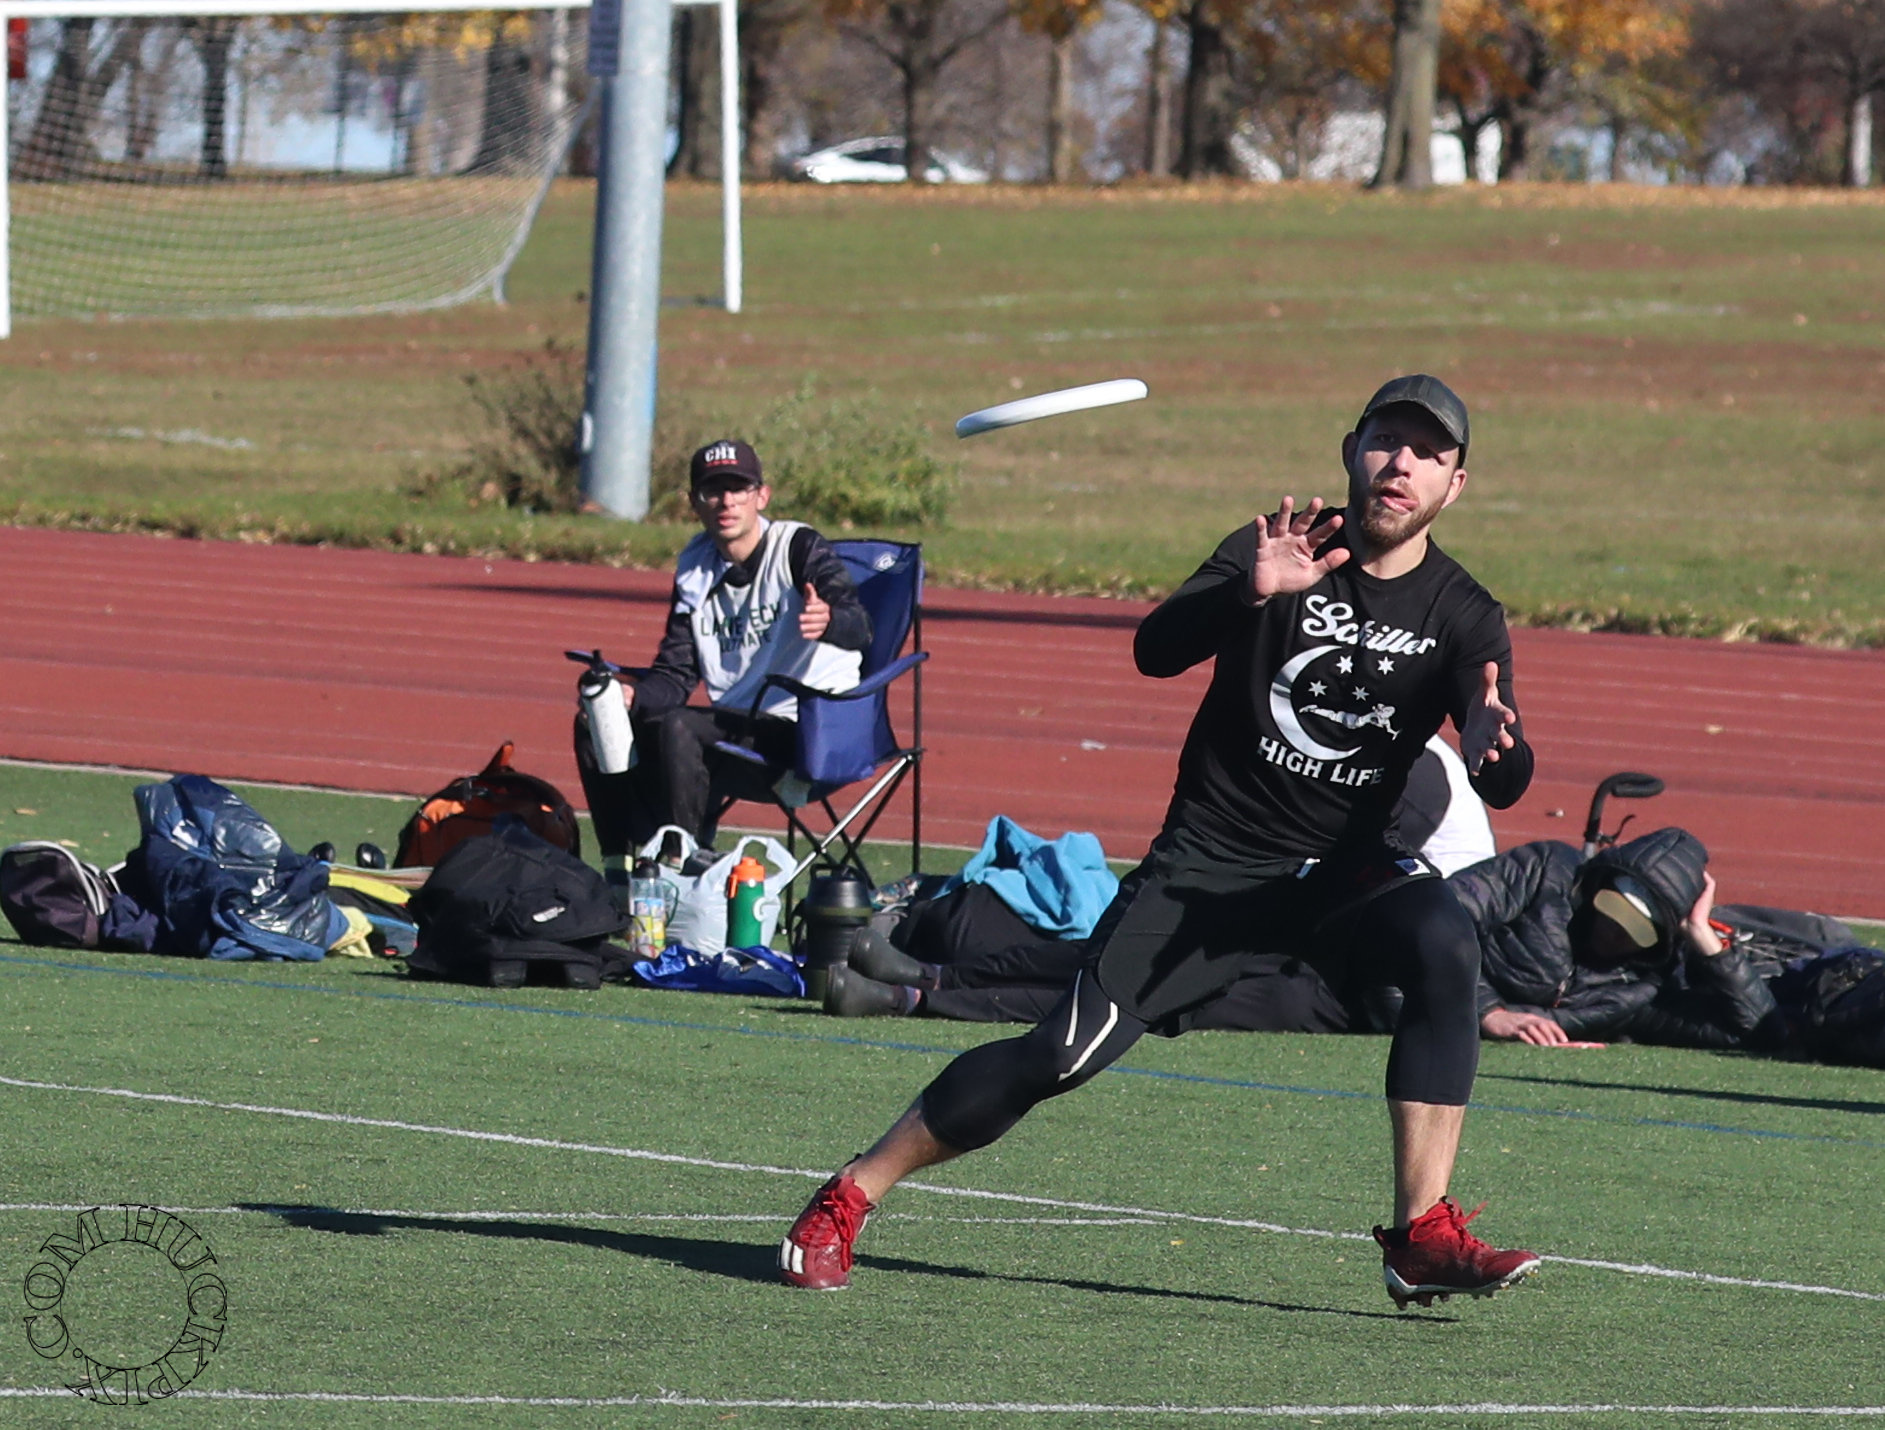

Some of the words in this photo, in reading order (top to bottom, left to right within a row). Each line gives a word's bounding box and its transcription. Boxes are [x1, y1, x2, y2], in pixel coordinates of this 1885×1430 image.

[705, 446, 737, 462] CHI
[1302, 594, 1437, 655] Schiller
[1258, 736, 1324, 779] HIGH
[1330, 763, 1385, 787] LIFE
